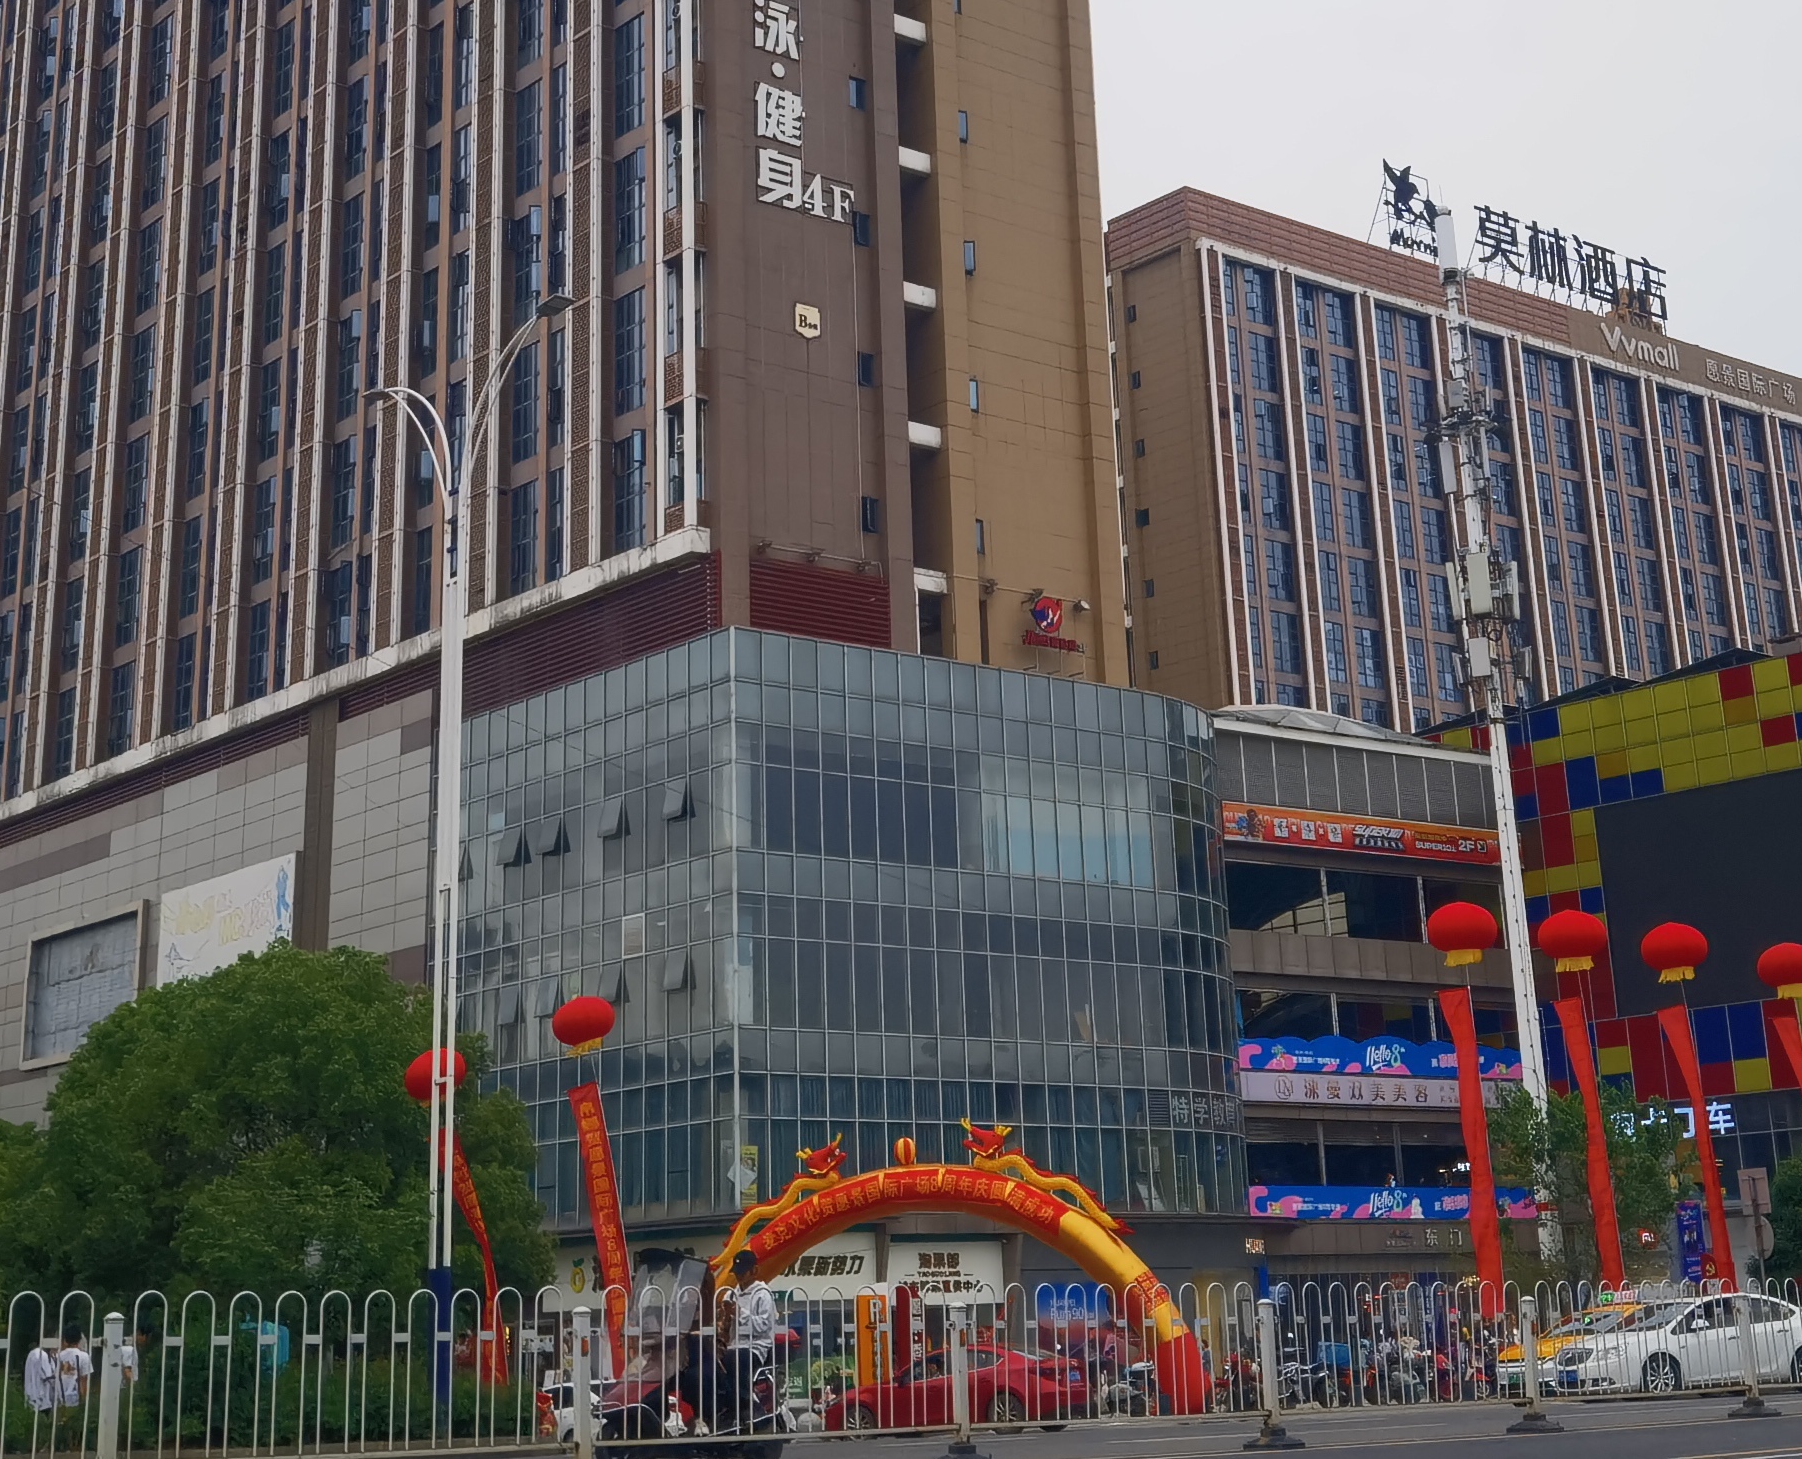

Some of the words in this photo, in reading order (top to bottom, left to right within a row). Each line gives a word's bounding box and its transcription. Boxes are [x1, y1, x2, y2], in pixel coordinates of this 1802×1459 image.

[802, 173, 855, 224] 4F
[1474, 205, 1668, 320] 莫林酒店
[1705, 358, 1797, 405] 愿景国际广场
[1425, 1227, 1463, 1246] 东门
